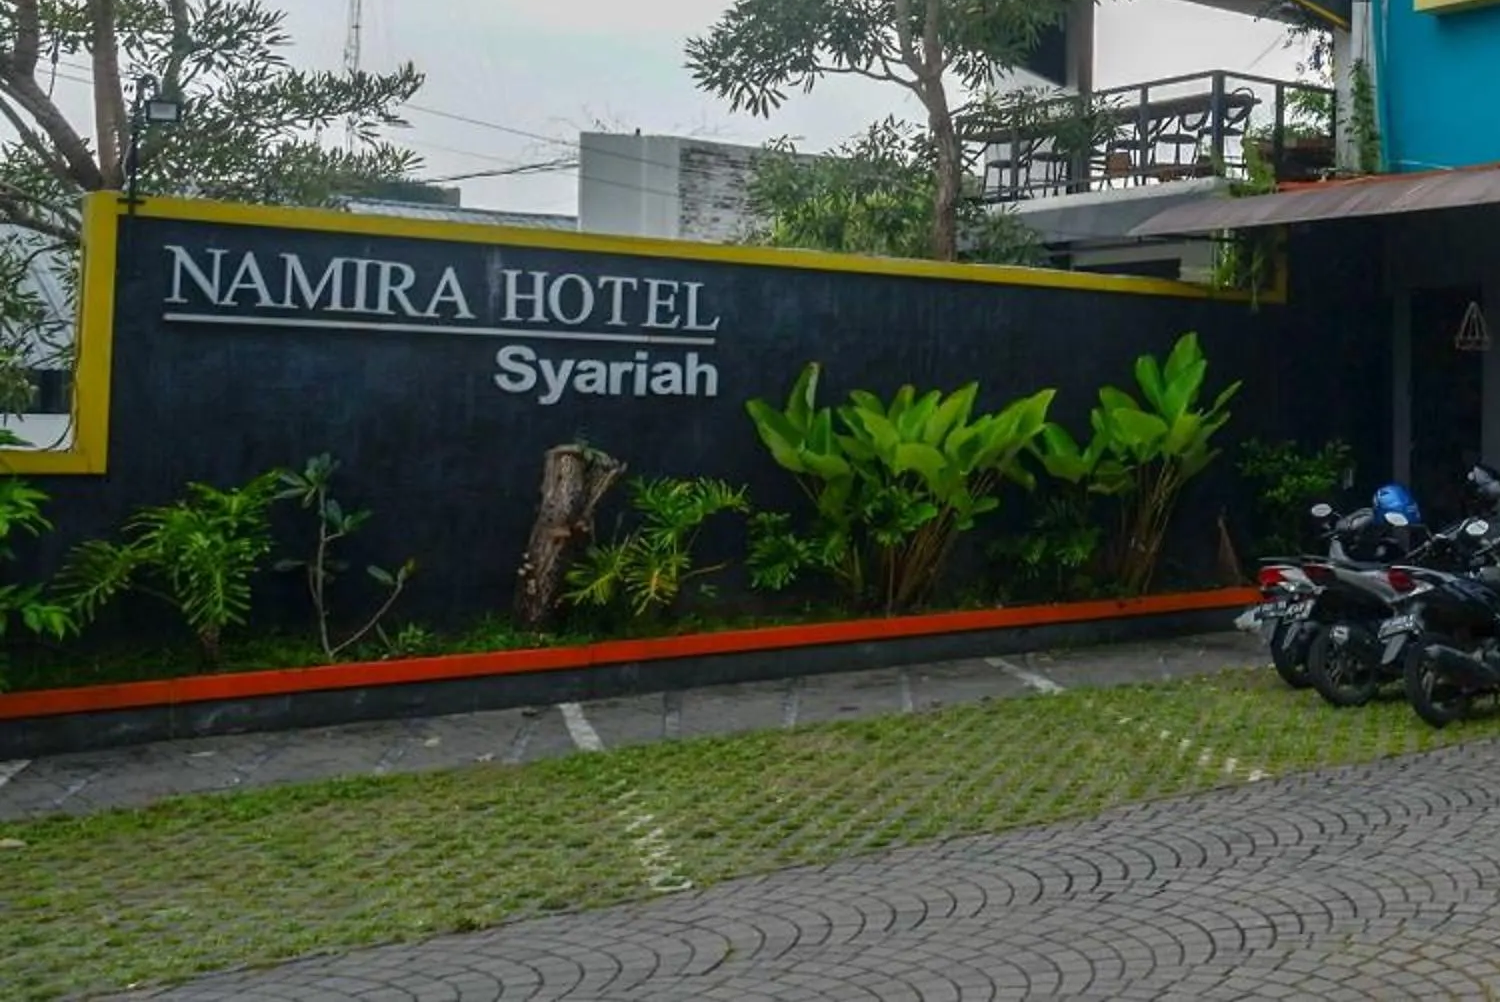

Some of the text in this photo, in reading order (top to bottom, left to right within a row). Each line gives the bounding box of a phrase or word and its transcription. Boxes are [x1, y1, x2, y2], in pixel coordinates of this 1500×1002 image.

[163, 245, 721, 332] NAMIRA HOTEL
[494, 344, 718, 405] Syariah
